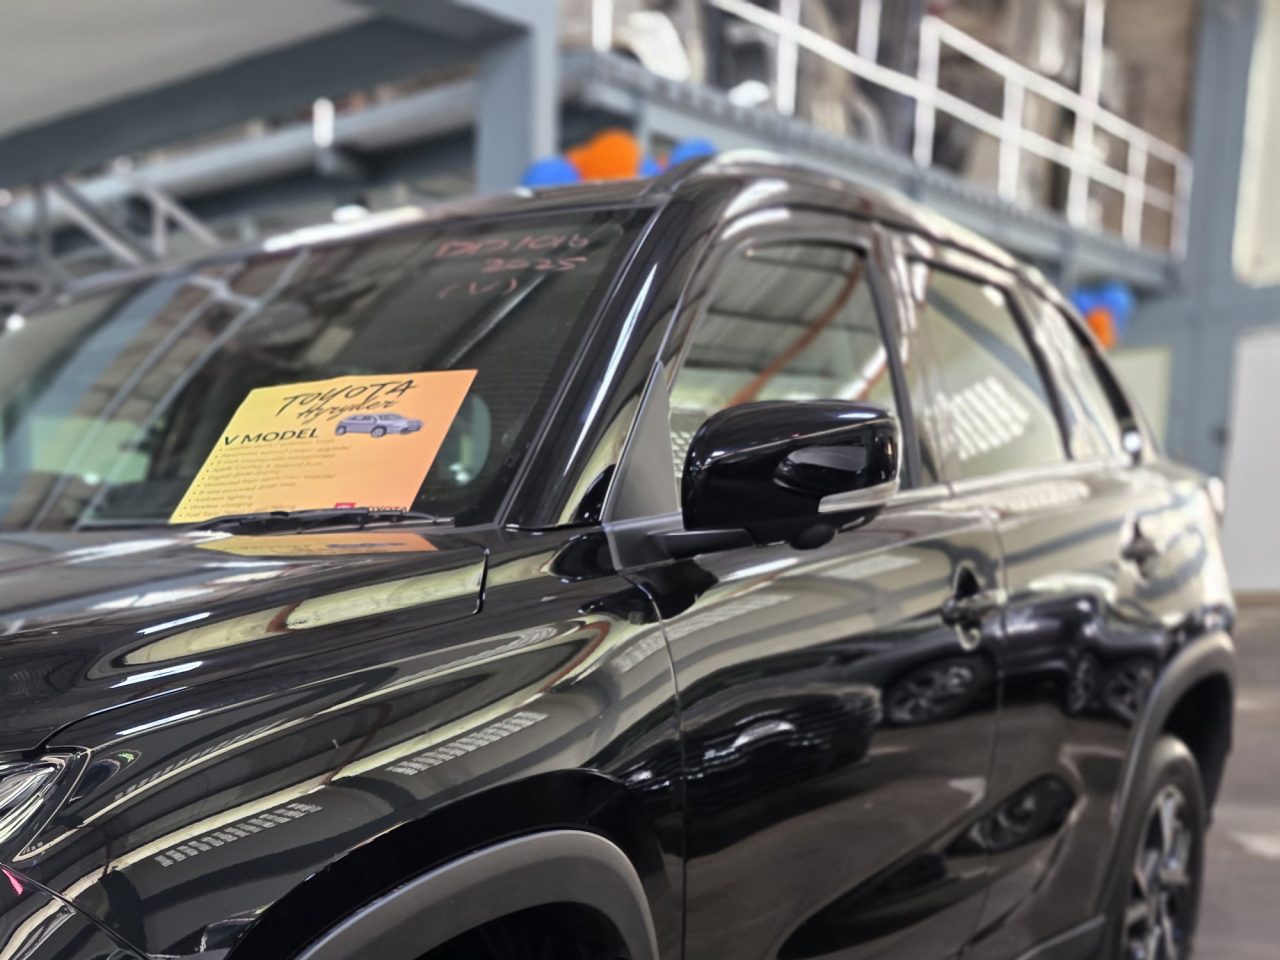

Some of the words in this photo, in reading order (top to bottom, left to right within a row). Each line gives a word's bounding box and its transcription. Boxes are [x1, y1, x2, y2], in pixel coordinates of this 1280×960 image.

[480, 256, 588, 273] 2025
[276, 379, 418, 417] TOYOTA
[224, 434, 240, 446] V
[241, 428, 319, 444] MODEL
